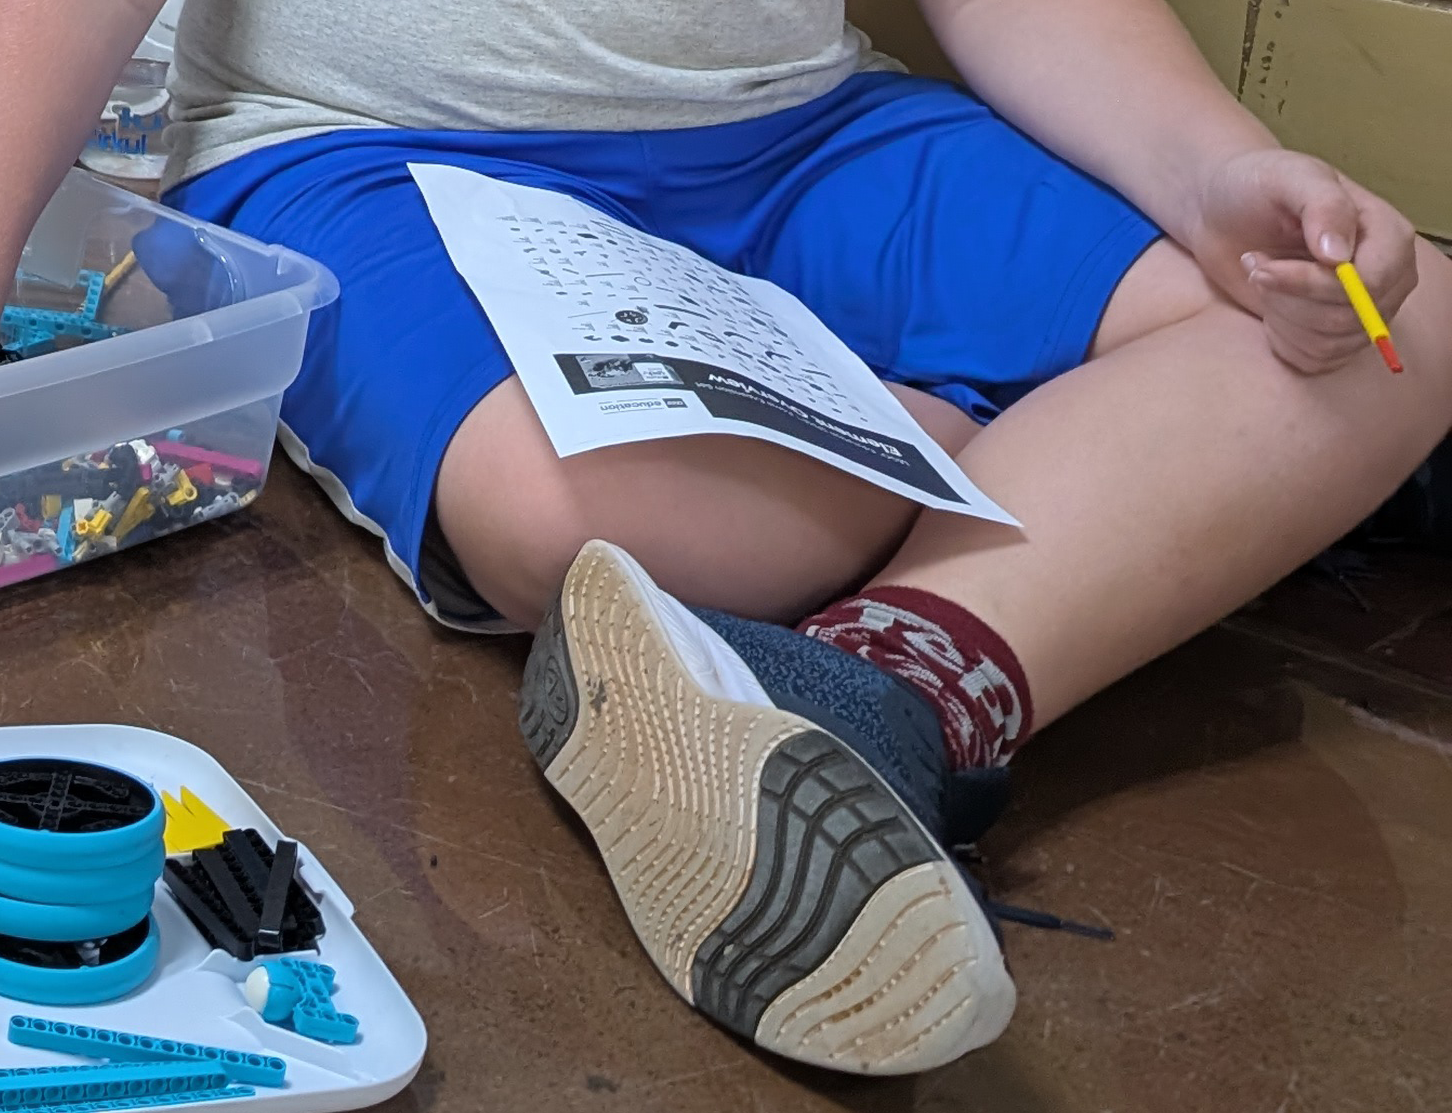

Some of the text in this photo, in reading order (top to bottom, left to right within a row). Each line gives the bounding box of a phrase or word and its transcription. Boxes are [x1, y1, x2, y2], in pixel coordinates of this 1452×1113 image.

[599, 400, 663, 412] education
[708, 373, 809, 420] Overview
[809, 413, 903, 458] Element
